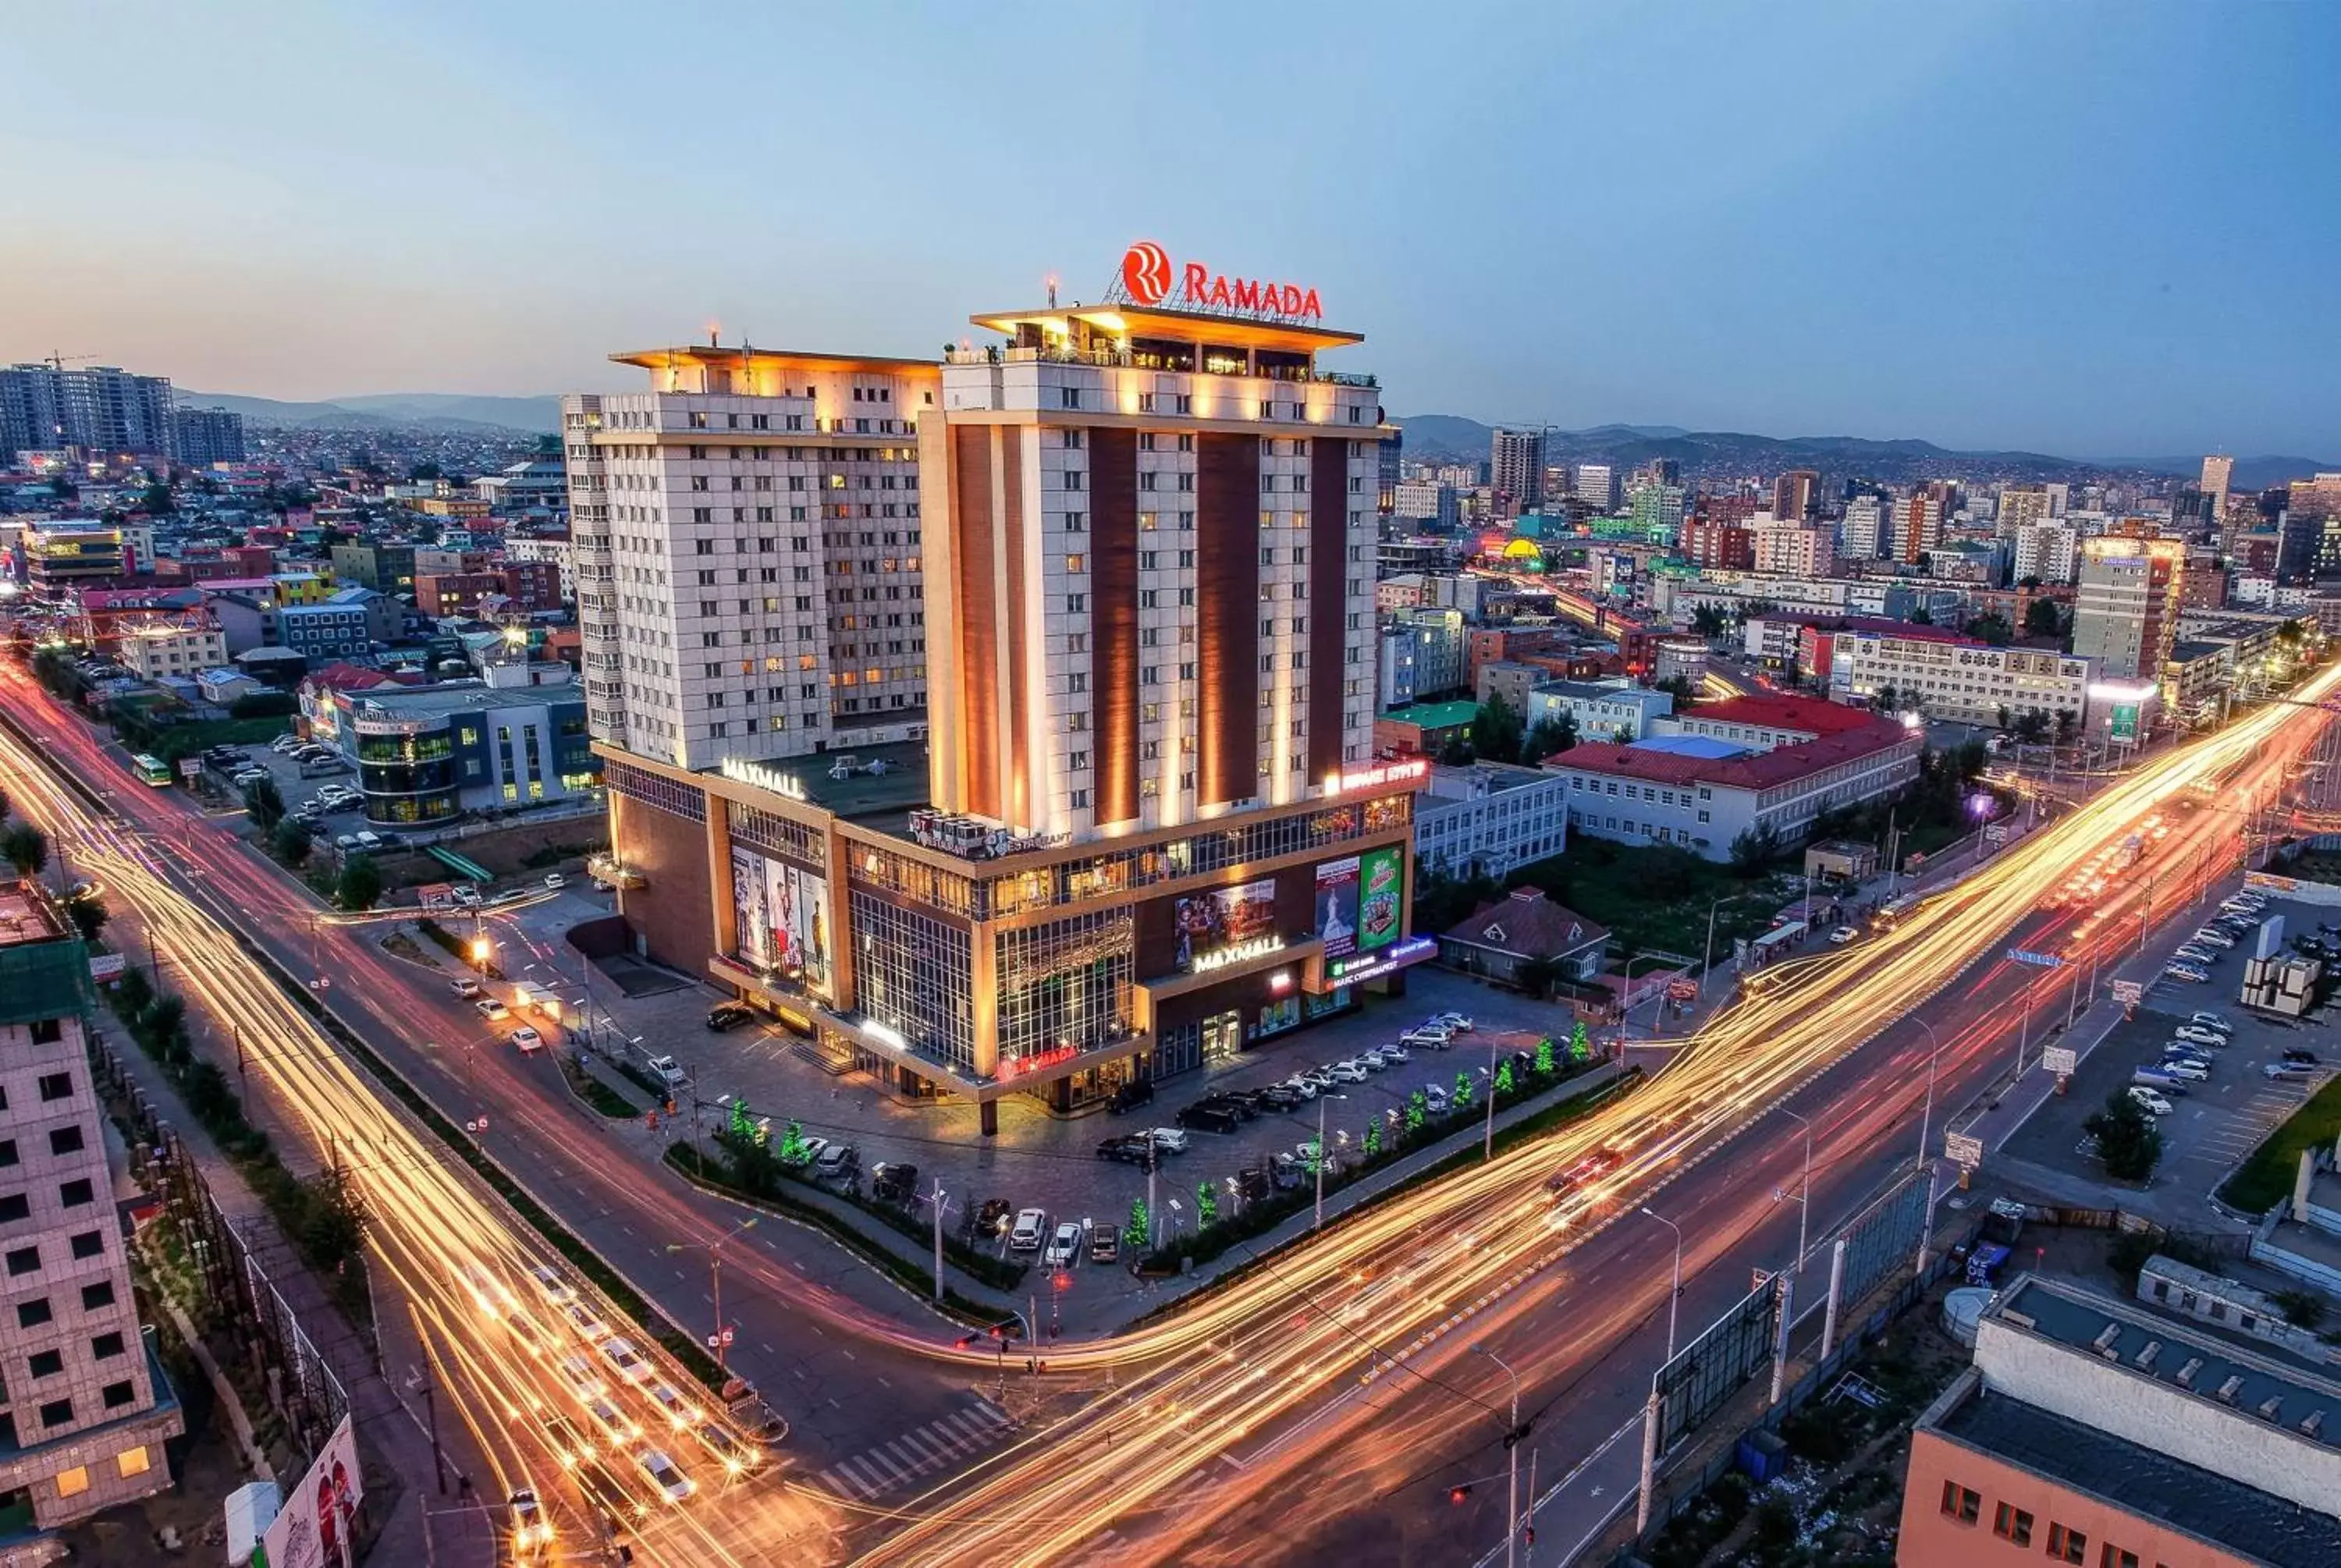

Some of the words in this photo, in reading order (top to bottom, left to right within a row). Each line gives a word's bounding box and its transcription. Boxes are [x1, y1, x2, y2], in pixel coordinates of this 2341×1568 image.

[1185, 263, 1322, 319] RAMADA
[722, 756, 805, 800] MAXMALL
[1193, 935, 1286, 974] MAXMALL
